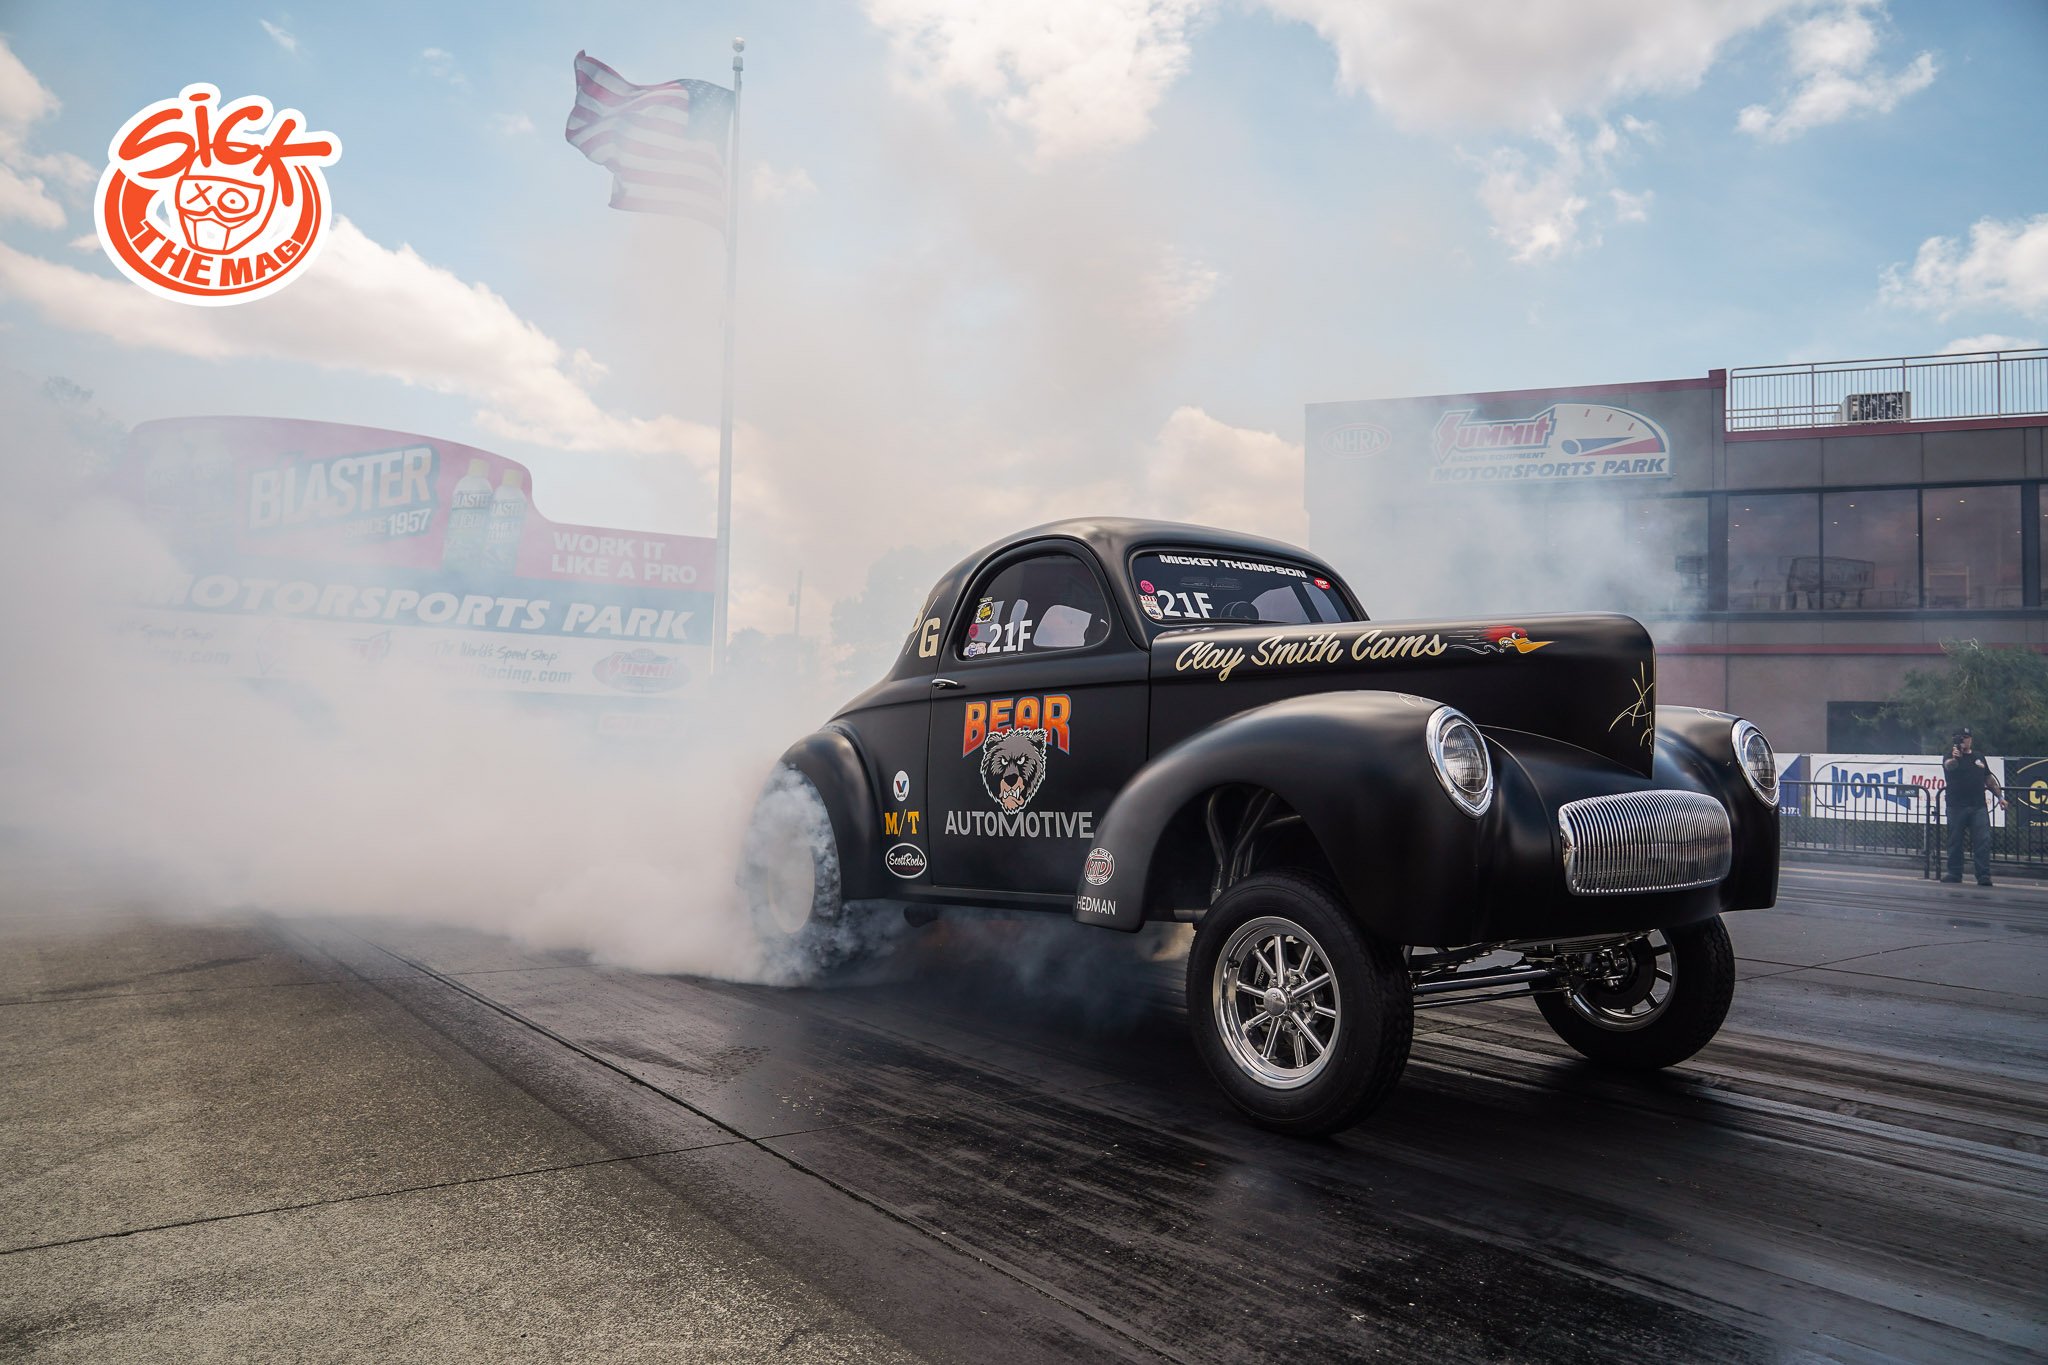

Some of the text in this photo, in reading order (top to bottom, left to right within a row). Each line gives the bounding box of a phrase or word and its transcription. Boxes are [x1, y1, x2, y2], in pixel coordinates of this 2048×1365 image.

[1332, 428, 1386, 453] NHRA
[1432, 457, 1667, 482] MOTORSPORTS PARK
[249, 447, 432, 530] BLASTER
[387, 507, 431, 537] 1957
[552, 530, 666, 561] WORK IT
[551, 553, 698, 586] LIKE A PRO
[1159, 554, 1307, 579] MICKEY THOMPSON
[1156, 589, 1214, 619] 21F
[561, 602, 696, 641] PARK
[987, 620, 1033, 654] 21F
[497, 645, 529, 665] Speed
[531, 648, 559, 667] Shop
[1175, 629, 1448, 682] Clay Smith Cams
[963, 693, 1071, 758] BEAR
[1832, 765, 1911, 810] MOREL
[885, 809, 920, 837] M/T
[945, 811, 1095, 839] AUTOMOTIVE
[1076, 895, 1116, 915] HEDMAN
